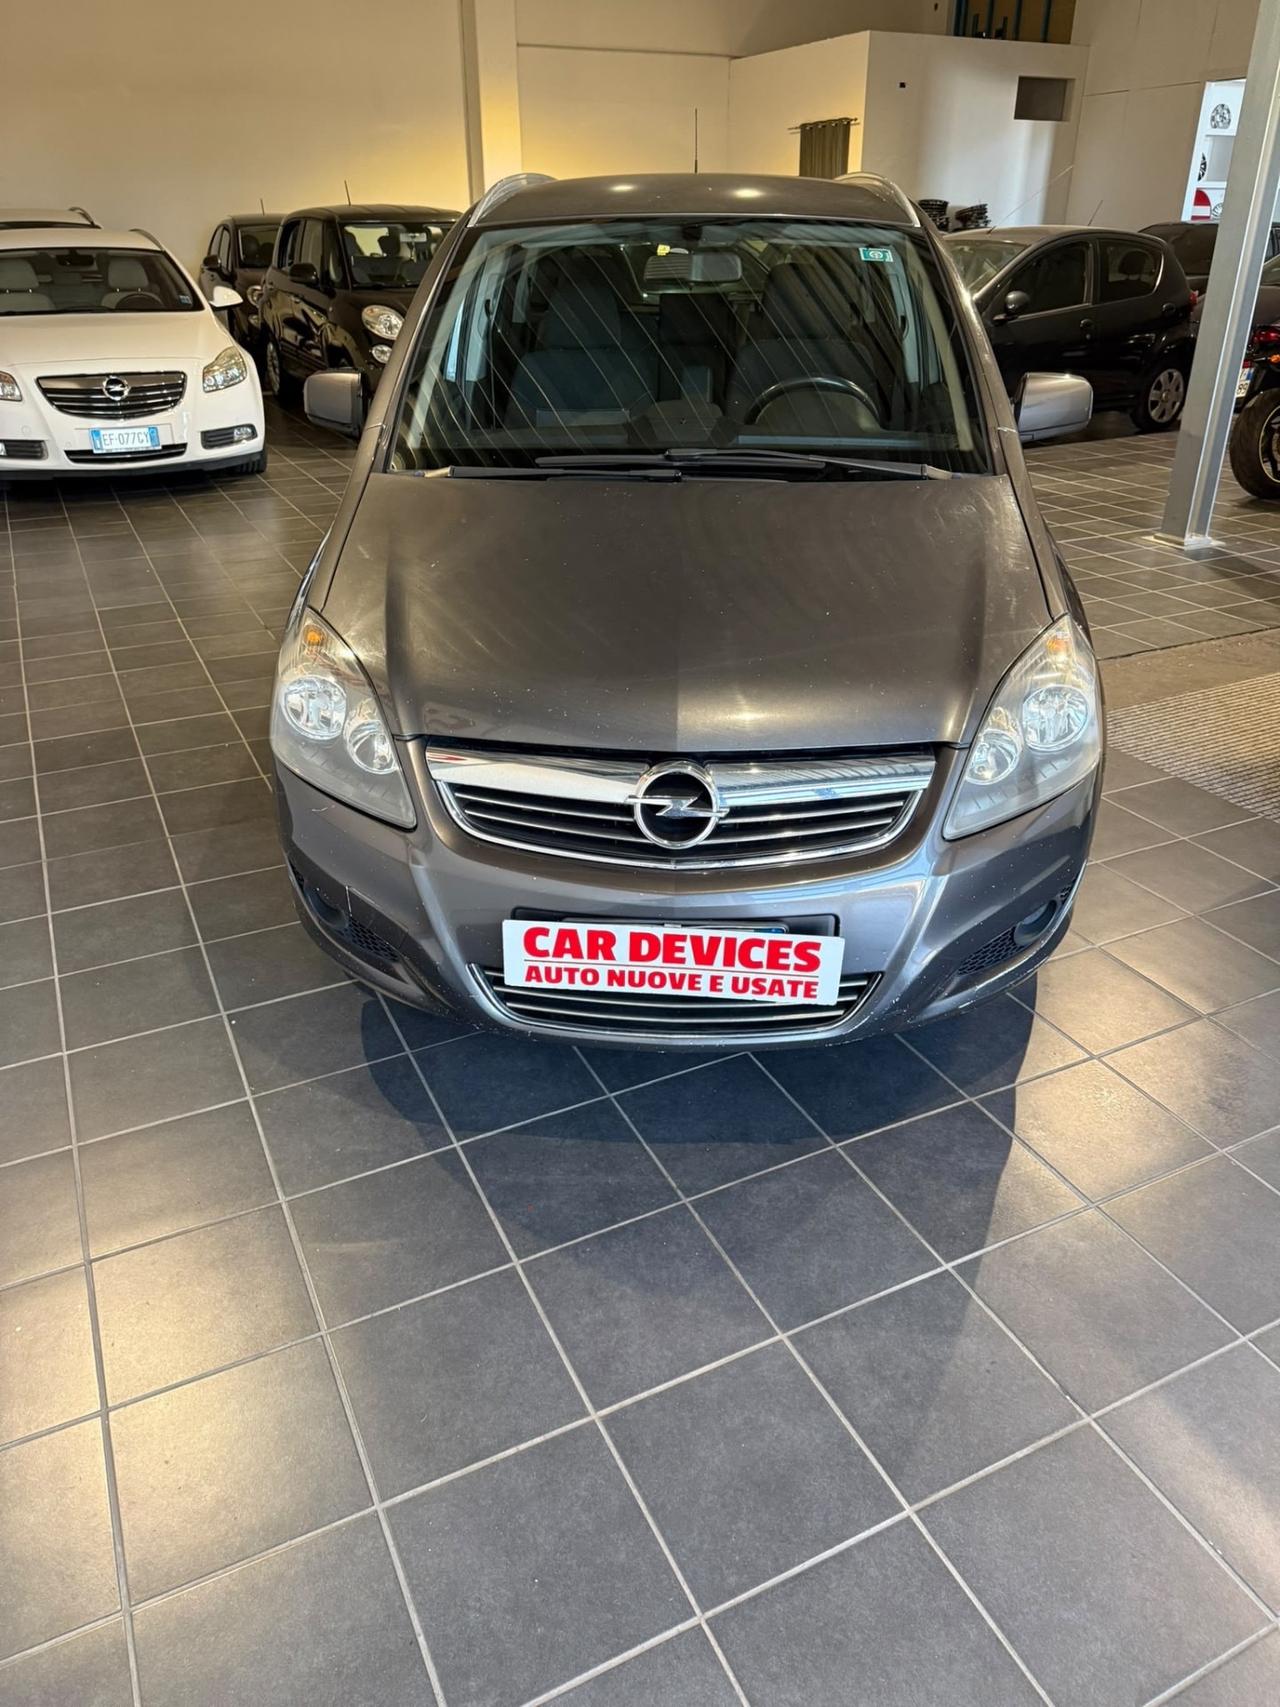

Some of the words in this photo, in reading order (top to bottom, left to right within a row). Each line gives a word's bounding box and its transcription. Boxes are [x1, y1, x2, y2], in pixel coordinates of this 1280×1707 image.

[523, 926, 617, 961] CAR
[628, 931, 821, 972] DEVICES
[525, 965, 600, 986] AUTO
[607, 969, 702, 991] NUOVE
[709, 975, 724, 993] E
[731, 976, 818, 998] USATE
